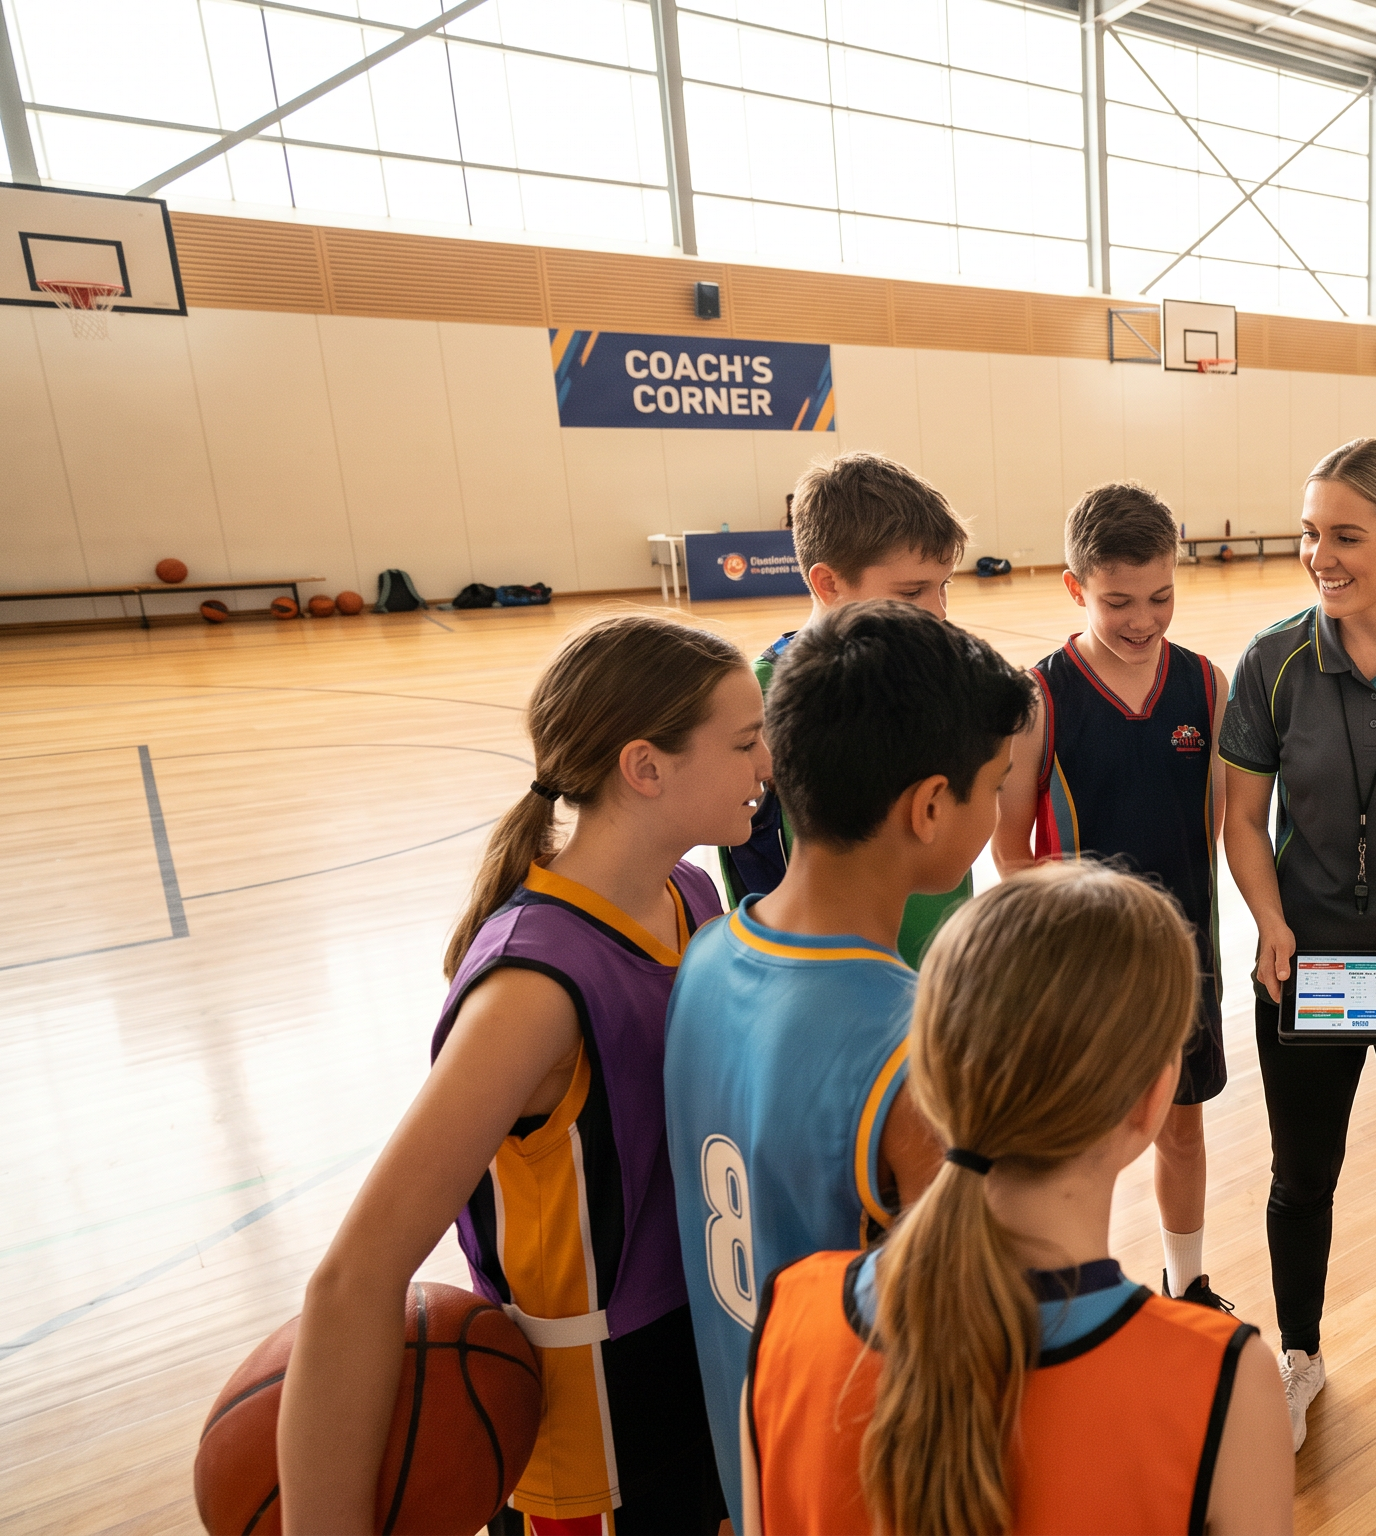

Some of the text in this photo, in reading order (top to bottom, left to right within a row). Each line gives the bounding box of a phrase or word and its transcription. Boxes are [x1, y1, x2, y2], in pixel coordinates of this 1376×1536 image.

[624, 349, 774, 385] COACH'S
[632, 384, 773, 416] CORNER
[701, 1133, 758, 1333] 8
